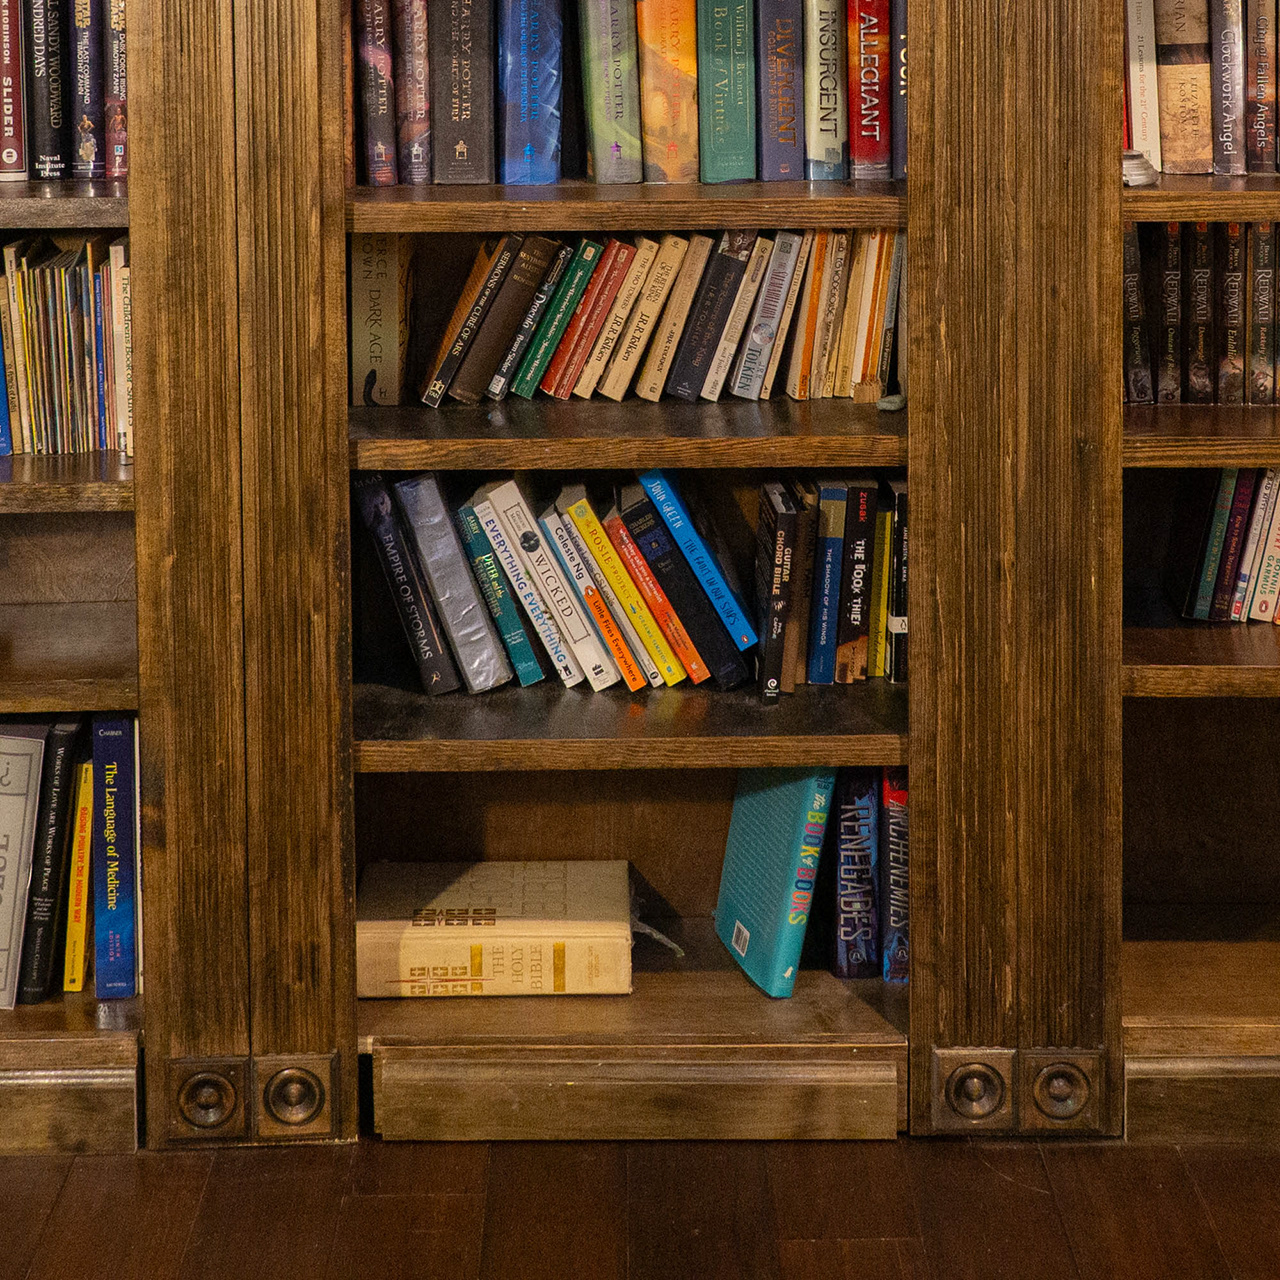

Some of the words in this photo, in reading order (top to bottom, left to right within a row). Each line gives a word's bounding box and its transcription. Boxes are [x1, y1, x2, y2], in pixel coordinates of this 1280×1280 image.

[2, 9, 11, 64] ROBINSON
[818, 10, 839, 137] INSURGENT
[859, 12, 881, 140] ALLEGIANT
[1221, 29, 1235, 108] Clockwork
[3, 76, 14, 137] SLIDER
[1220, 113, 1237, 155] Angel
[367, 290, 381, 329] DARK
[522, 292, 547, 329] Dracula
[368, 333, 382, 364] AGE
[647, 480, 667, 500] JOHN
[660, 501, 684, 529] GREEN
[774, 530, 785, 566] CHORD
[781, 547, 792, 582] GUITAR
[484, 519, 527, 591] EVERYTHING
[522, 592, 567, 663] EVERYTHING
[533, 554, 573, 618] WICKED
[771, 567, 782, 595] BIBLE
[104, 762, 118, 785] The
[102, 787, 119, 844] Language
[106, 846, 119, 858] of
[840, 805, 871, 941] RENEGADES
[106, 861, 120, 910] Medicine
[492, 945, 504, 977] THE
[511, 945, 523, 984] HOLY
[530, 946, 542, 990] BIBLE
